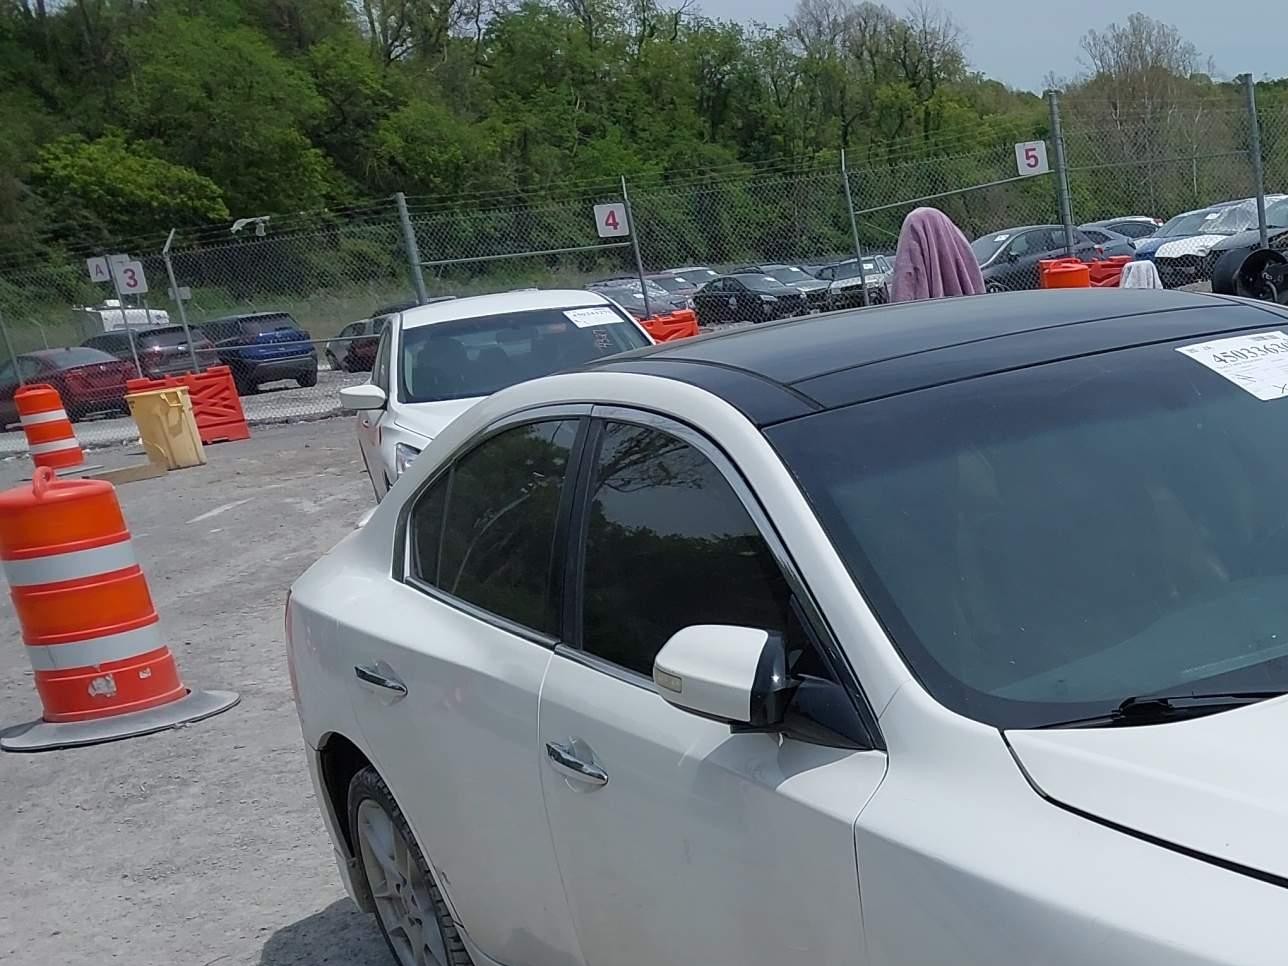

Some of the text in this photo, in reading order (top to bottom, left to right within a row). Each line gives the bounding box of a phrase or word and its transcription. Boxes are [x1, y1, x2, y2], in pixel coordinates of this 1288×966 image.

[1025, 147, 1039, 168] 5
[605, 210, 620, 230] 4
[95, 264, 105, 277] A
[123, 268, 138, 288] 3
